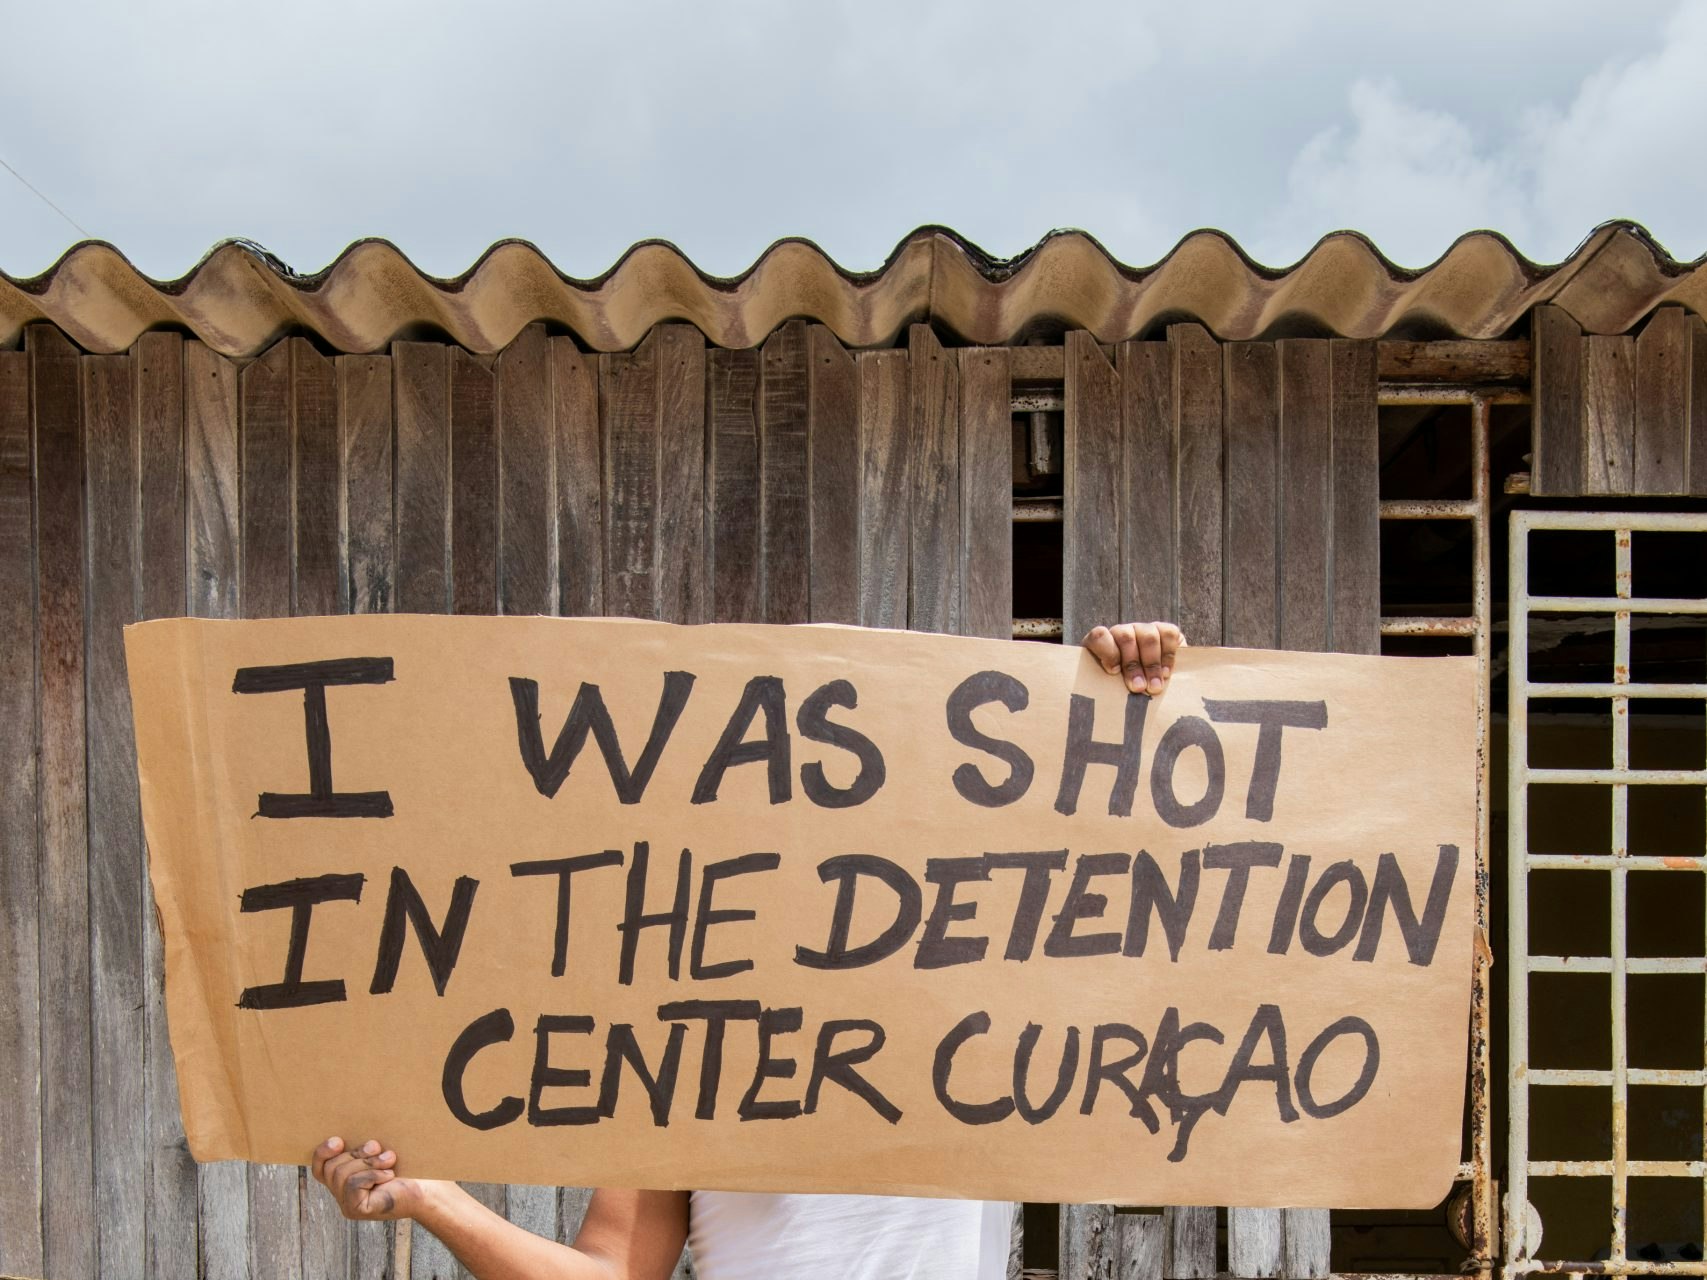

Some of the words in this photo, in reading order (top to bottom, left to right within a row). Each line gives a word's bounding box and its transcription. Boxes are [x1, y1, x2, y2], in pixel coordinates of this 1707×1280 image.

[232, 657, 397, 819] I
[508, 670, 886, 808] WAS
[946, 670, 1328, 828] SHOT
[235, 866, 480, 1010] IN
[510, 841, 781, 986] THE
[793, 841, 1459, 970] DETENTION
[441, 999, 904, 1132] CENTER
